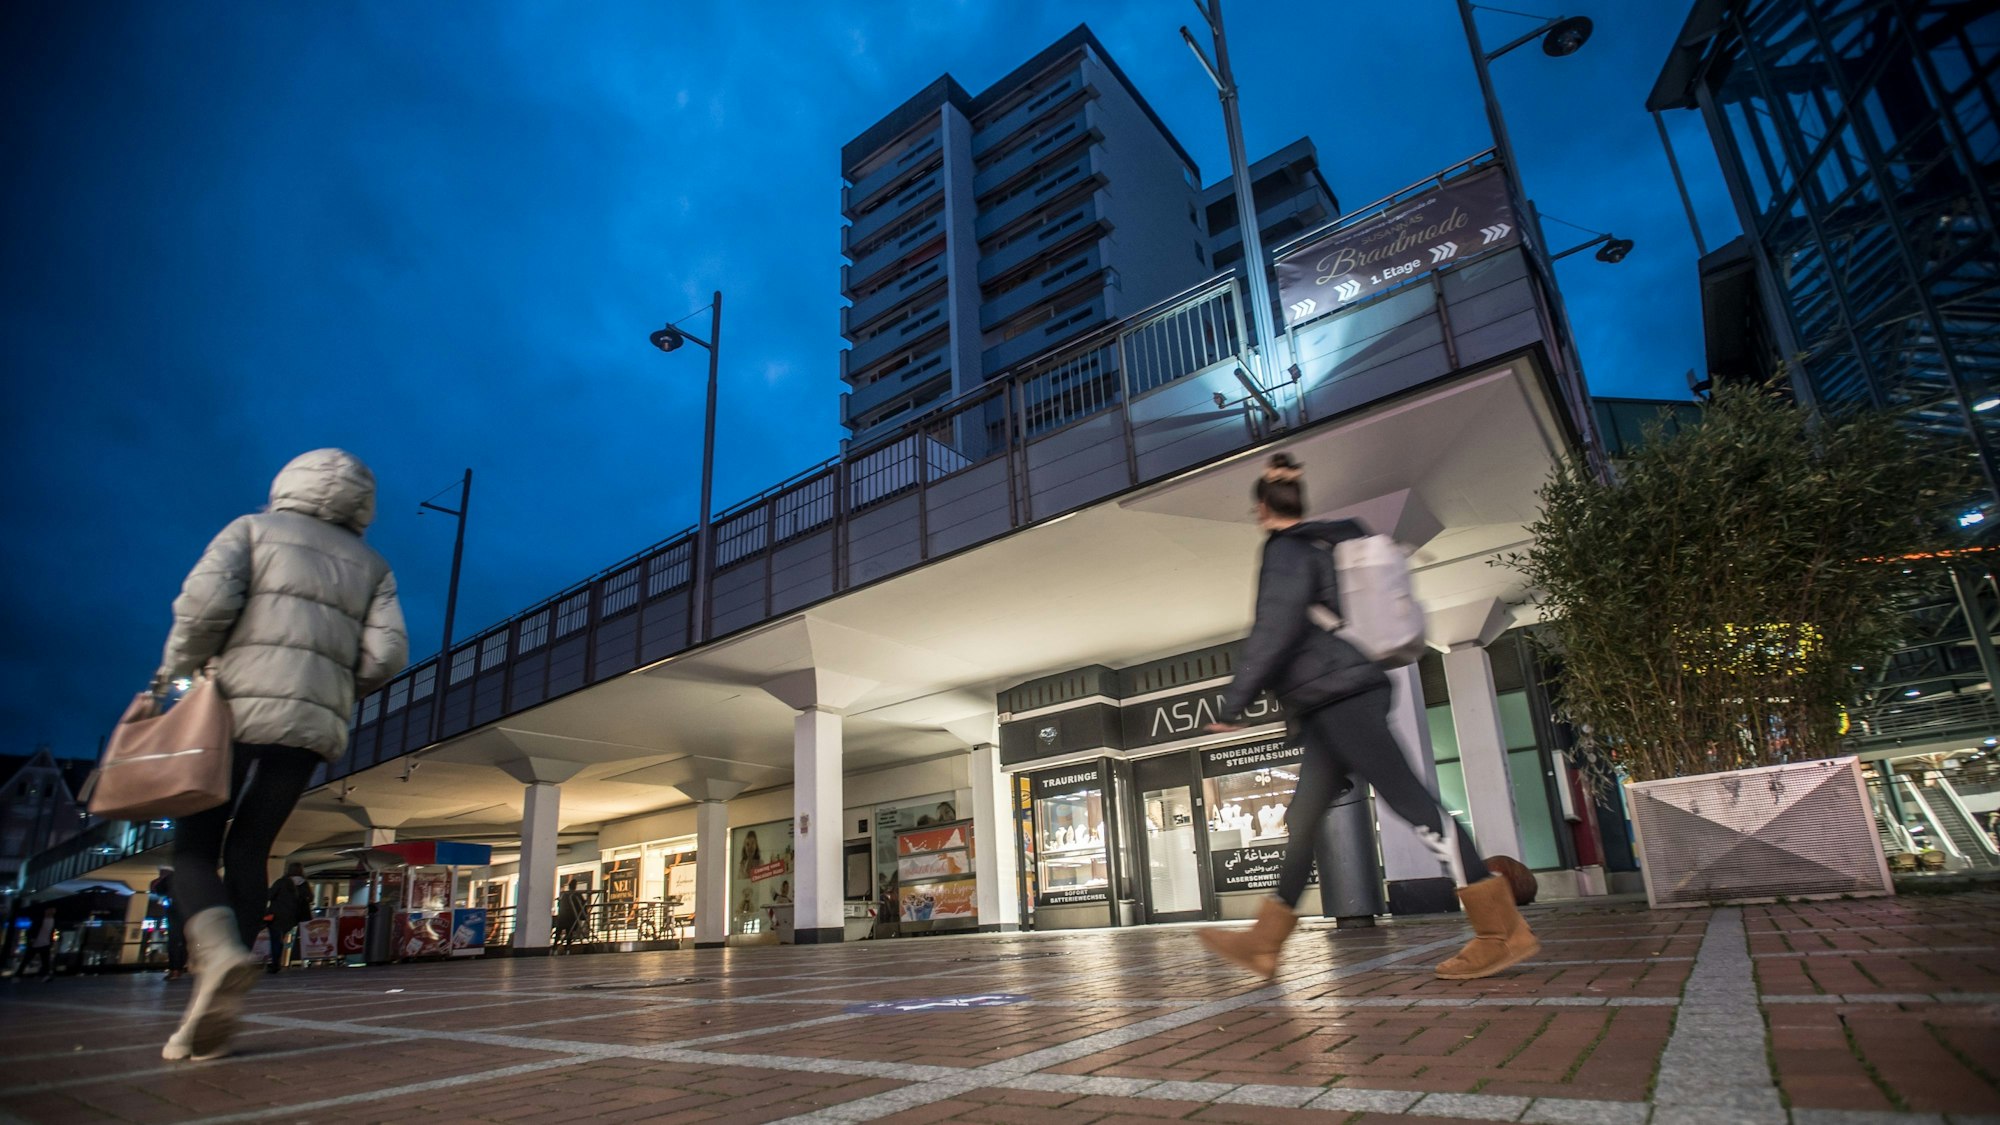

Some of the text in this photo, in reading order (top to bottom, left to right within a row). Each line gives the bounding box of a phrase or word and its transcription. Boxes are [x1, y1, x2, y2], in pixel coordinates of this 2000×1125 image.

[1361, 213, 1424, 245] SUSANNAS
[1315, 206, 1469, 286] Brautmode
[1383, 258, 1421, 281] Etage
[1042, 771, 1098, 788] TRAURINGE
[1050, 893, 1107, 904] BATTERIEWECHSEL
[1064, 889, 1089, 897] SOFORT
